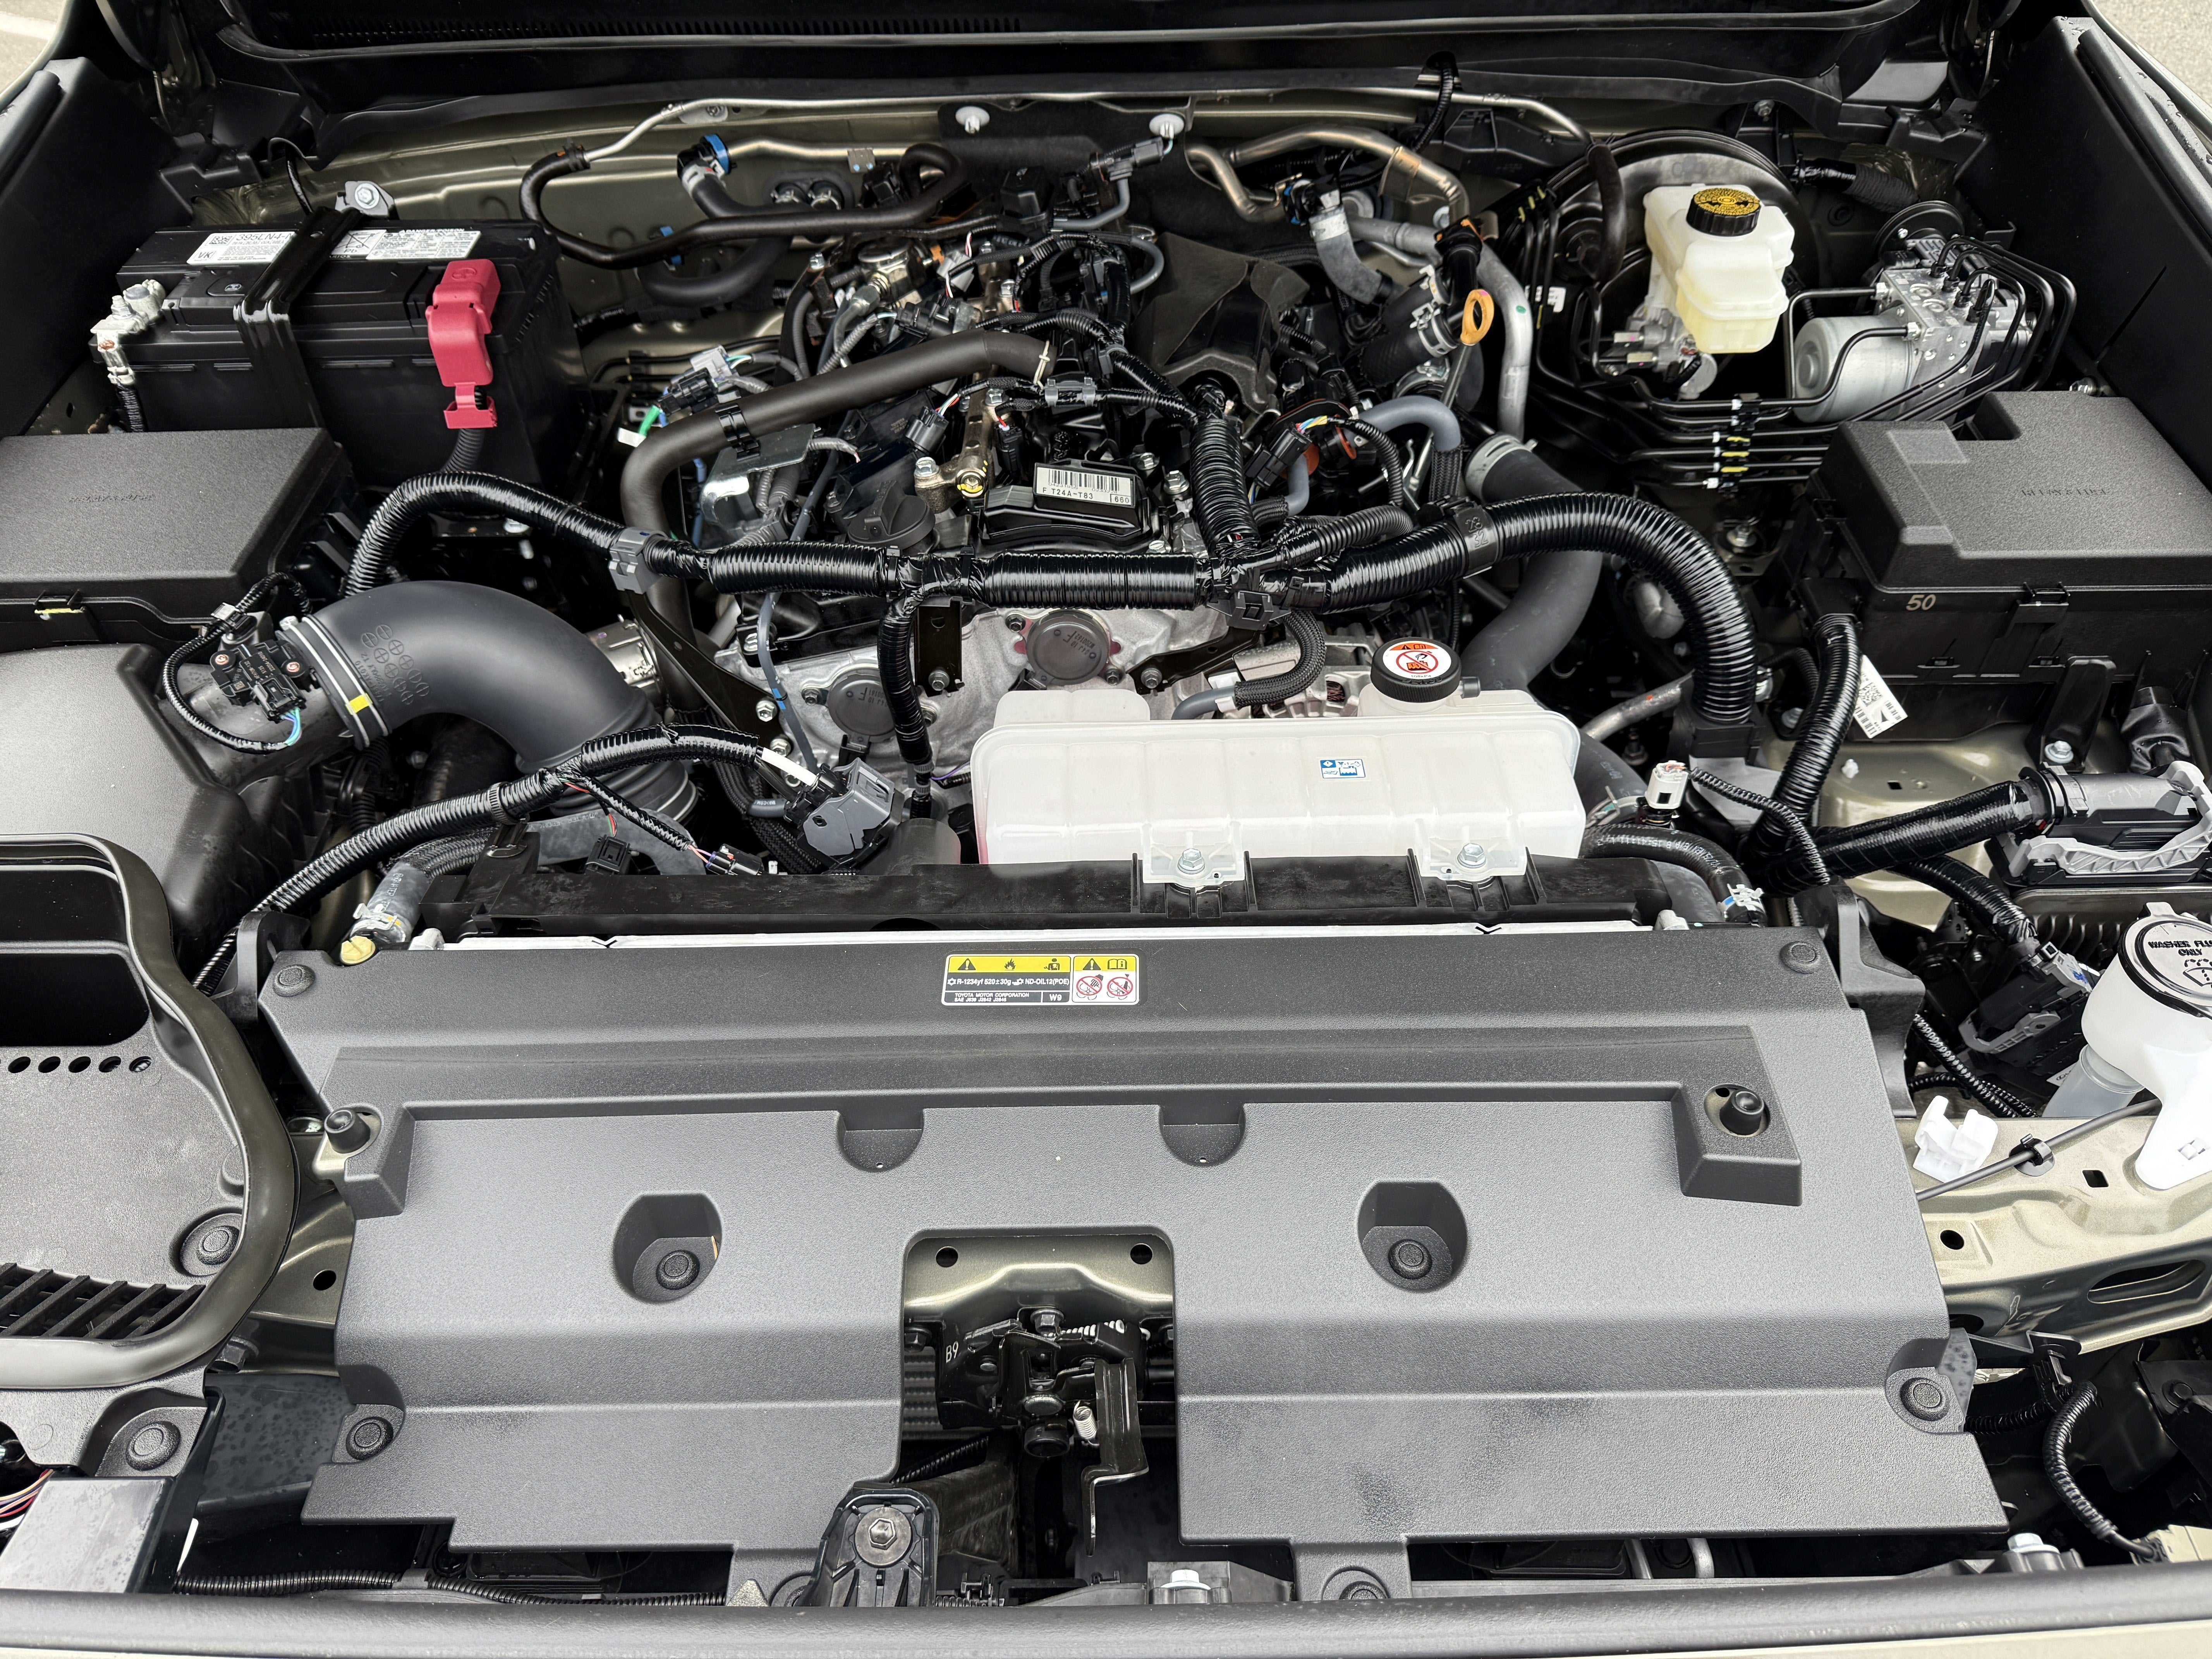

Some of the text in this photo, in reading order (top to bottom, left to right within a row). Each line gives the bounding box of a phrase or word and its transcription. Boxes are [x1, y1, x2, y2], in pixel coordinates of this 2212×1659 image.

[1051, 488, 1093, 499] T24A-T83
[1473, 529, 1489, 548] 32
[1906, 595, 1936, 611] 50
[945, 1341, 959, 1364] B9
